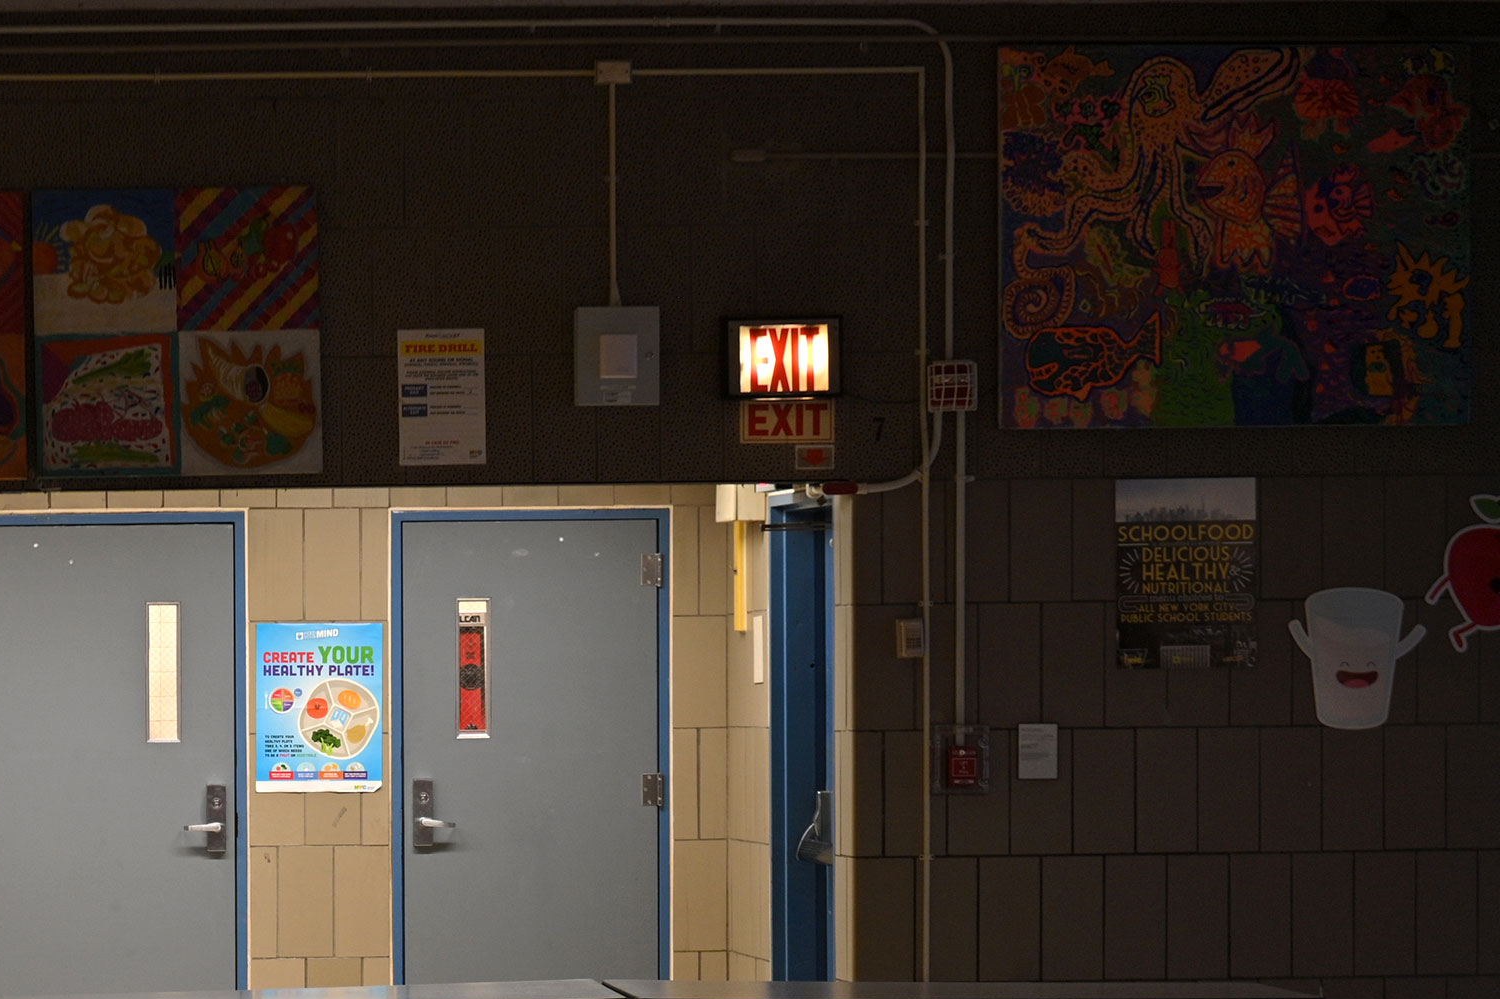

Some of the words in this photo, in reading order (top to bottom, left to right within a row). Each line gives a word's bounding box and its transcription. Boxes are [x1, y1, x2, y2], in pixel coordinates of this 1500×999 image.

[405, 344, 435, 353] FIRE
[438, 343, 478, 353] DRILL
[749, 327, 820, 392] EXIT
[748, 404, 828, 436] EXIT
[872, 417, 885, 441] 7
[1118, 524, 1254, 542] SCHOOLFOOD
[1141, 581, 1230, 595] NUTRITIONAL
[1138, 603, 1155, 612] ALL
[1159, 603, 1179, 612] NEW
[1183, 602, 1210, 611] YORK
[1213, 602, 1236, 610] CITY
[1120, 613, 1154, 624] PUBLIC
[1157, 612, 1200, 623] SCHOOL
[1204, 611, 1253, 622] STUDENTS
[316, 628, 340, 638] MIND
[263, 652, 314, 663] CREATE
[318, 646, 375, 664] YOUR
[263, 665, 323, 676] HEALTHY
[328, 665, 375, 676] PLATE!
